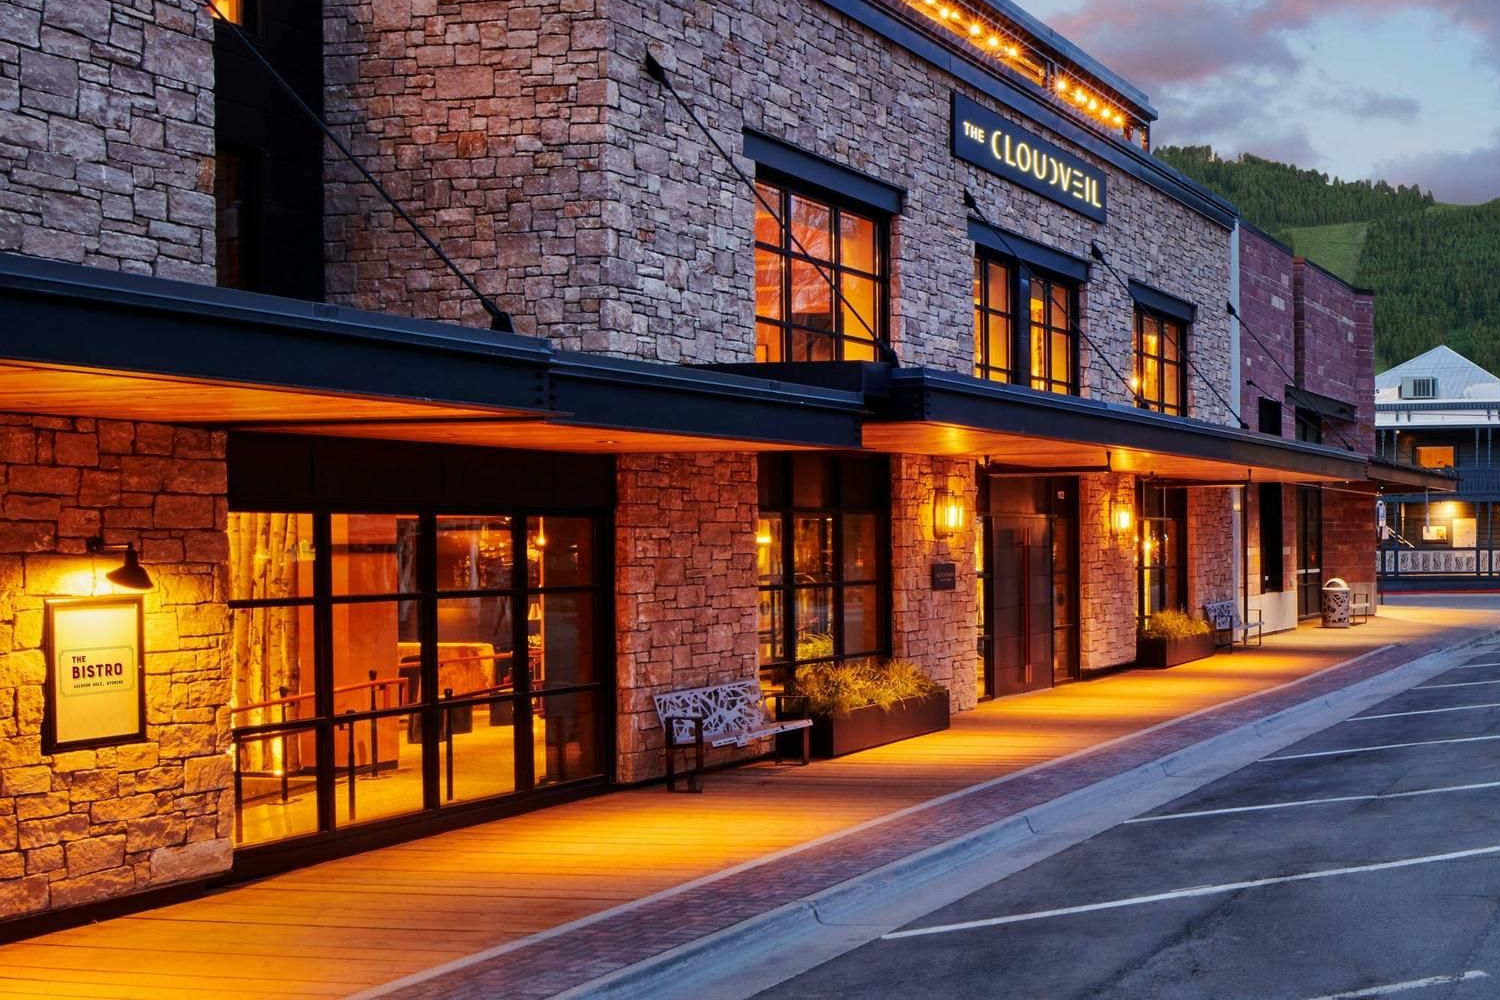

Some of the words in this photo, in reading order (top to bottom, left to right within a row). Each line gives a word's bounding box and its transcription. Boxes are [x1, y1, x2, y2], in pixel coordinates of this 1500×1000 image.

[963, 121, 985, 144] THE
[991, 130, 1102, 208] CLOUDVEIL
[72, 663, 122, 679] BISTRO
